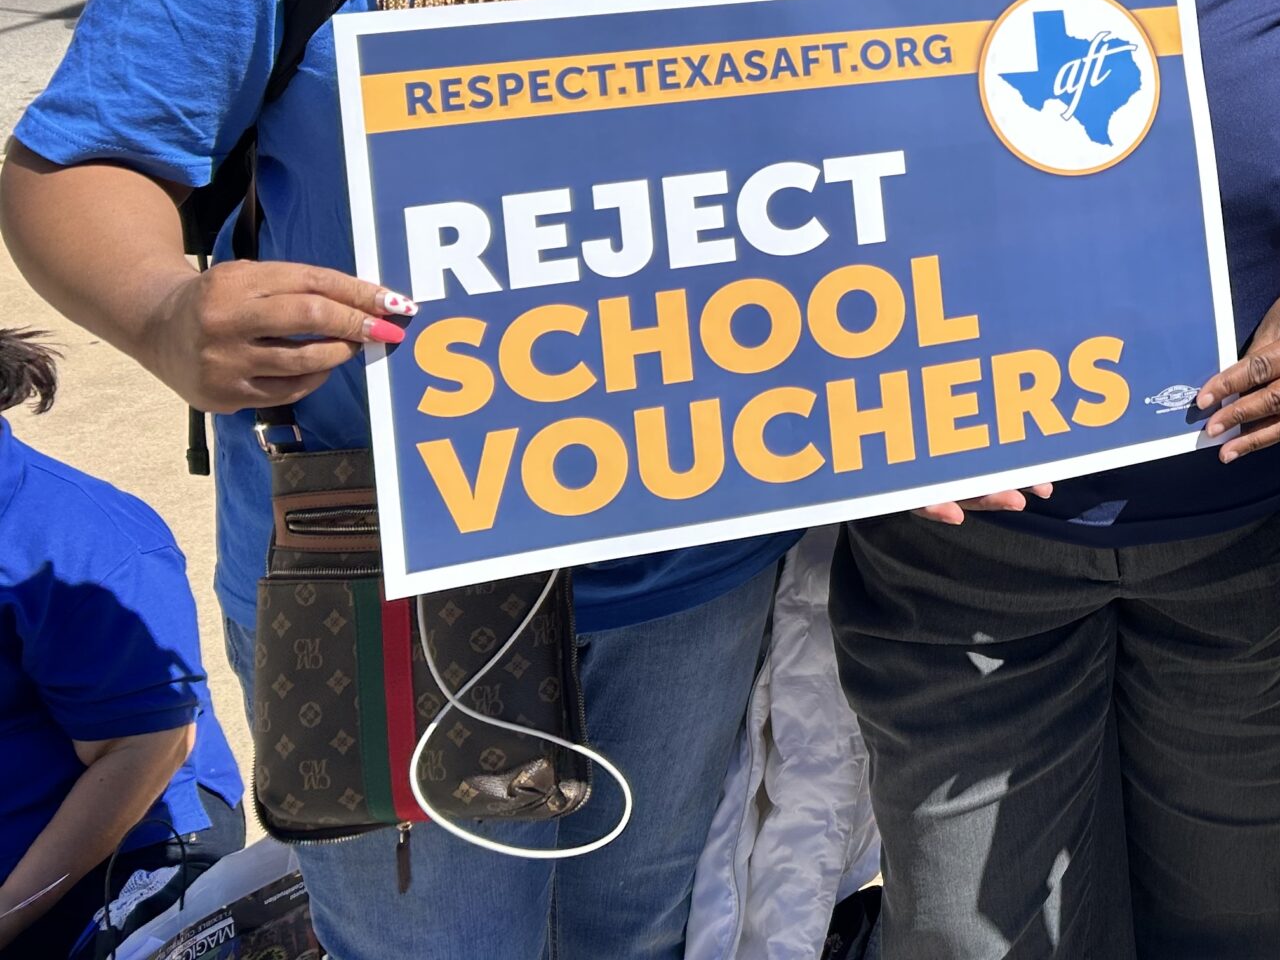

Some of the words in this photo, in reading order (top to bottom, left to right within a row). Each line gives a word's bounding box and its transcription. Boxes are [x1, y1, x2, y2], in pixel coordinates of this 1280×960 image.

[404, 33, 952, 116] RESPECT.TEXASAFT.ORG
[1053, 30, 1138, 121] aft
[404, 150, 906, 304] REJECT
[415, 256, 979, 418] SCHOOL
[416, 336, 1129, 533] VOUCHERS
